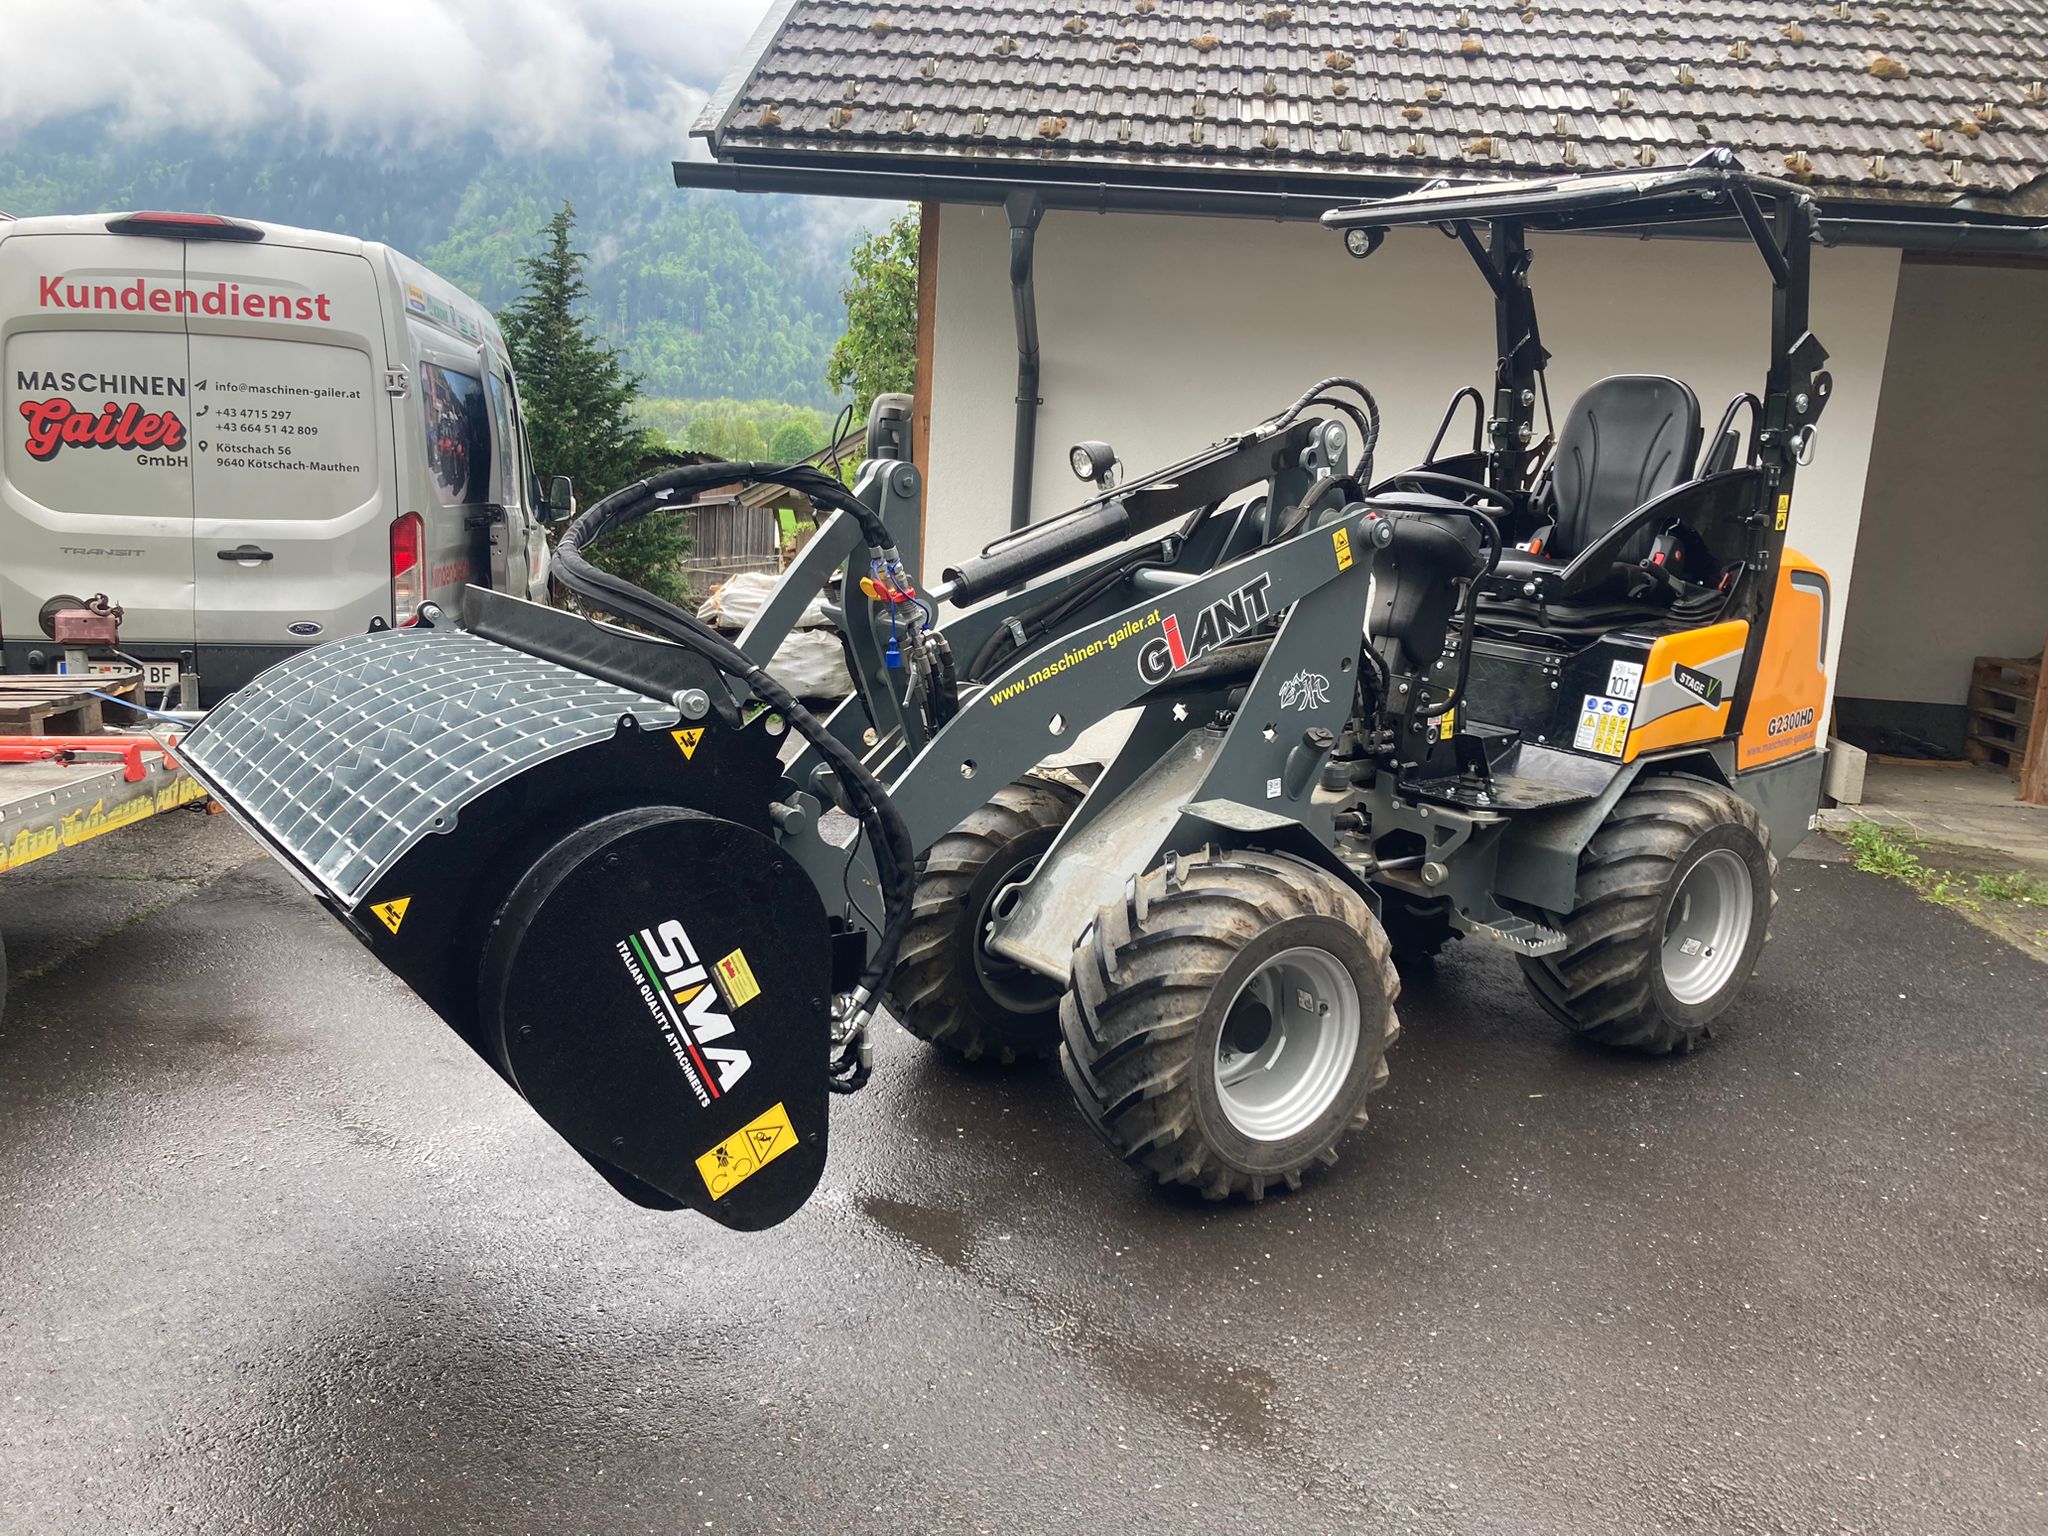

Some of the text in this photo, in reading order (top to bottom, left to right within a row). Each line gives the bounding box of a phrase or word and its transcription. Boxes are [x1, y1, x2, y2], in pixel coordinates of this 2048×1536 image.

[39, 275, 331, 322] Kundendienst
[17, 371, 186, 397] MASCHINEN
[215, 381, 361, 399] info@maschinen-gailer.at
[215, 408, 292, 420] +43 4715 297
[19, 397, 187, 462] Gailer
[215, 423, 318, 436] +43 664 51 42 809
[216, 443, 292, 456] Kötschach 56
[136, 454, 188, 467] GmbH
[216, 457, 360, 473] 9640 Kötschach-Mauthen
[59, 547, 146, 557] TRANSIT
[989, 608, 1161, 706] www.maschinen-gailer.at
[150, 666, 171, 683] BF
[1679, 672, 1706, 695] STAGE
[1611, 676, 1629, 696] 101
[1767, 707, 1815, 737] G2300HD
[640, 919, 752, 1093] SIMA
[616, 940, 711, 1108] ITALIAN QUALITY ATTACHMENTS
